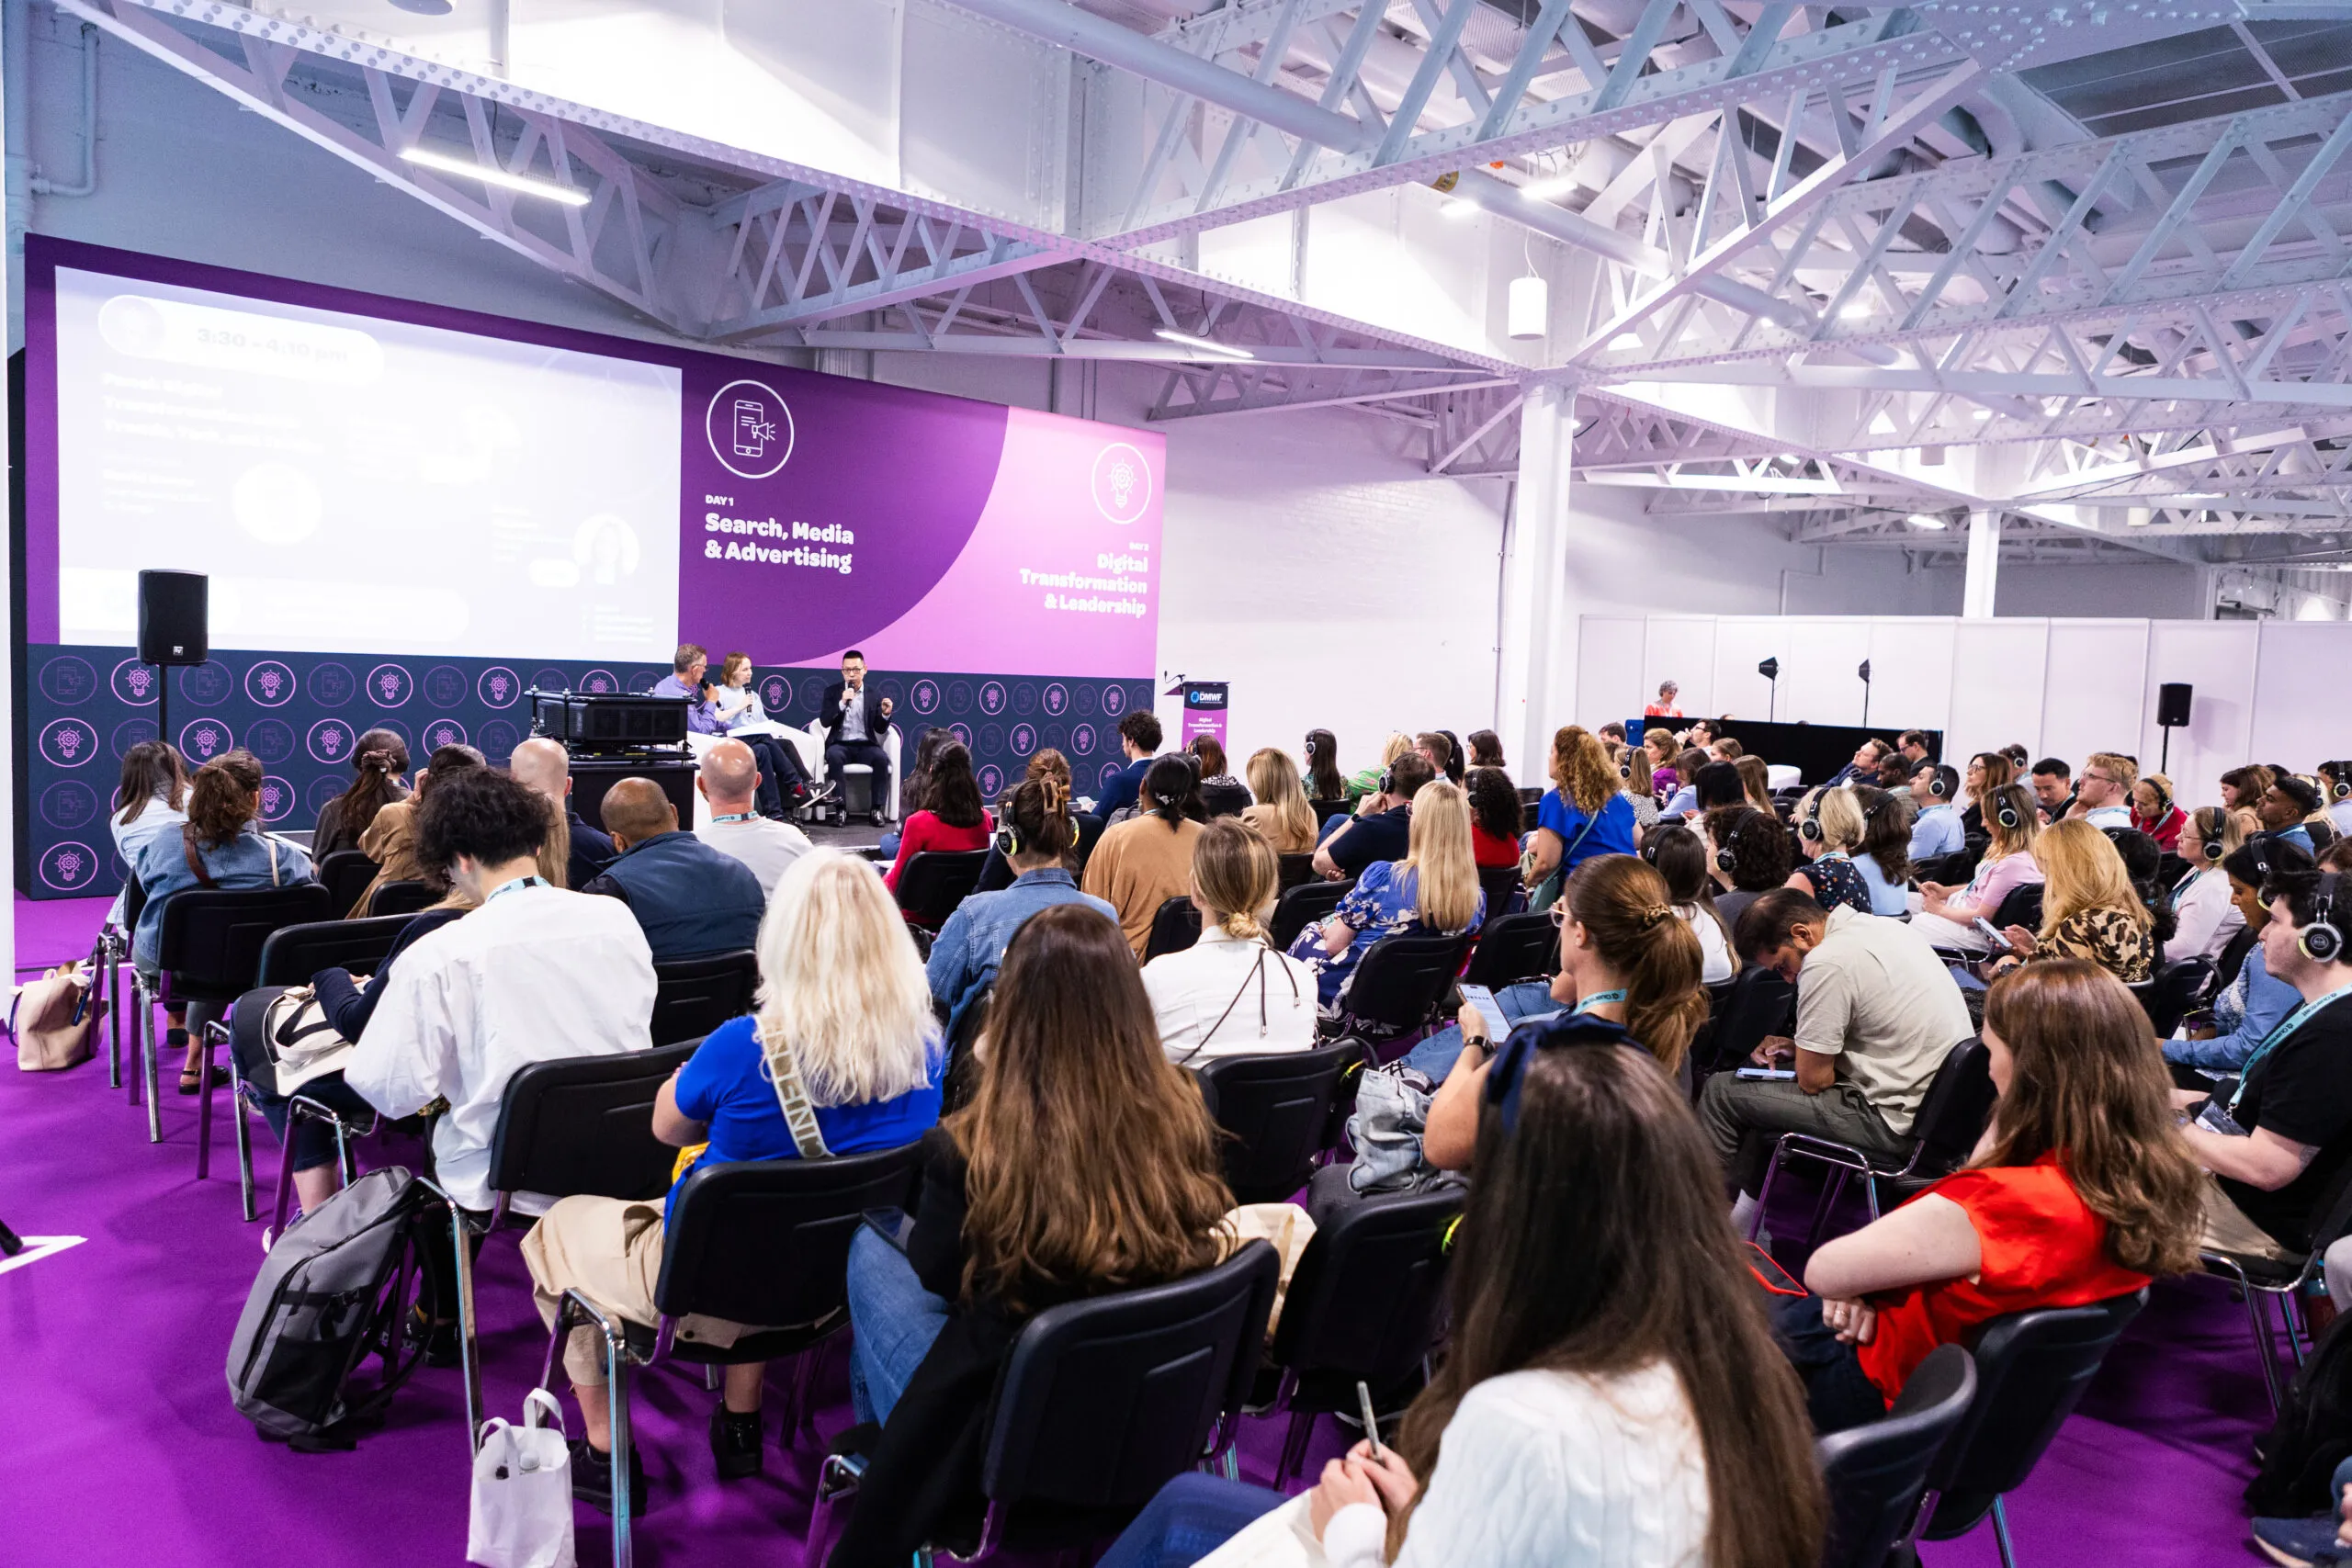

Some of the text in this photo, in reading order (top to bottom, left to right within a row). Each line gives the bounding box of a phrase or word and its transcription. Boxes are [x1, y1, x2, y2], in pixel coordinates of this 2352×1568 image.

[705, 494, 734, 506] DAY 1
[705, 513, 854, 545] Search, Media
[704, 539, 853, 574] & Advertising
[1097, 552, 1148, 574] Digital
[1019, 568, 1148, 594] Transformation
[1044, 592, 1147, 618] & Leadership
